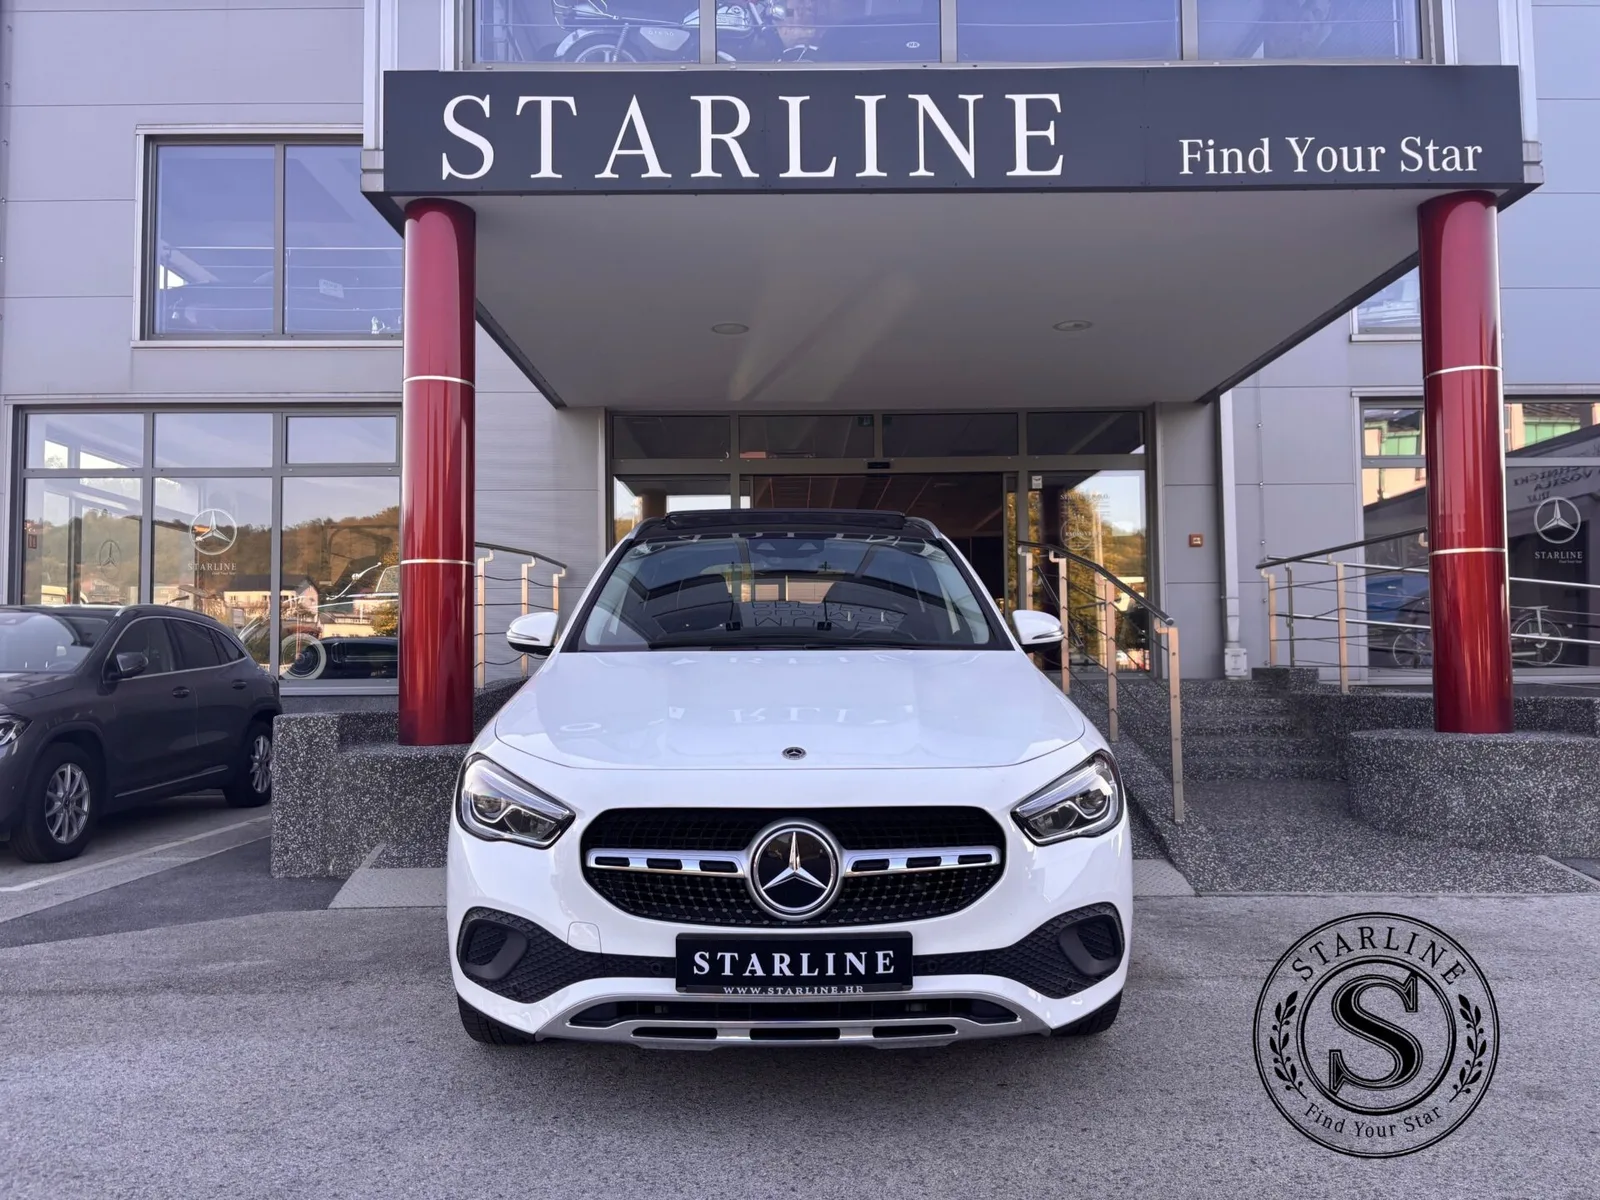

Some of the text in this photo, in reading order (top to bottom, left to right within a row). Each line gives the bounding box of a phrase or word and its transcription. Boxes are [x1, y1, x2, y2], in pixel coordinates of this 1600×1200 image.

[441, 94, 1064, 182] STARLINE
[1178, 135, 1483, 175] Find Your Star
[1534, 551, 1583, 560] STARLINE
[187, 562, 237, 571] STARLINE
[693, 950, 895, 976] STARLINE
[723, 985, 865, 996] WWW.STARLINE.HR
